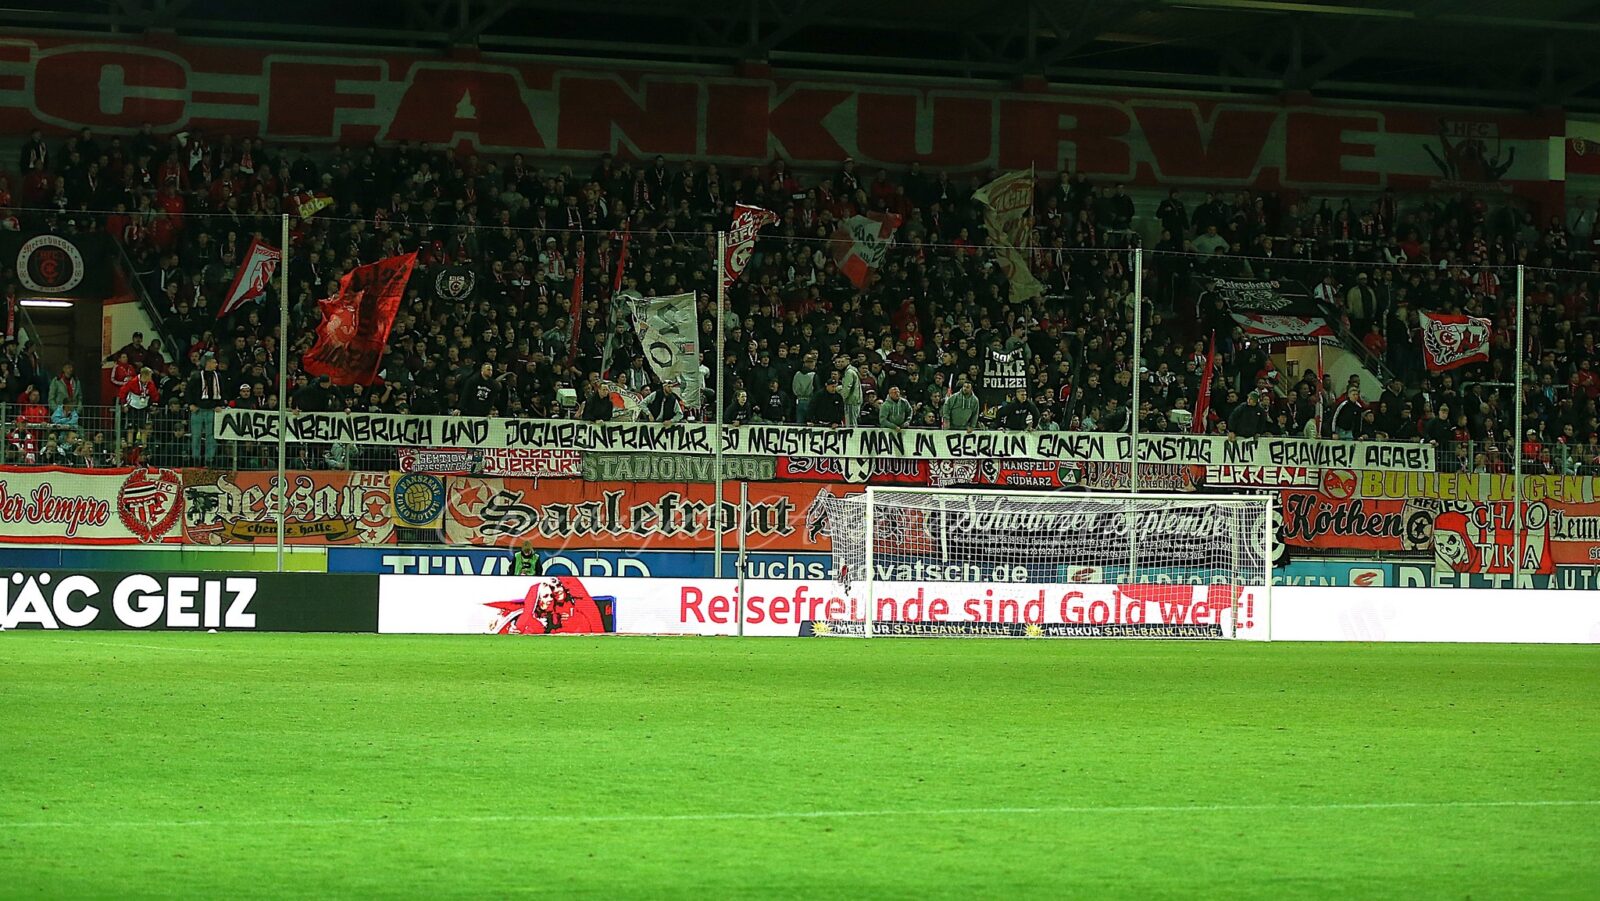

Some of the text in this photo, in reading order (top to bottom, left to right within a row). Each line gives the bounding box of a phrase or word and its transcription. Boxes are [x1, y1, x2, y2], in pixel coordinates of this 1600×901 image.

[0, 43, 1385, 190] C-FANKURVE
[1453, 122, 1490, 136] HFC
[984, 359, 1026, 376] LIKE
[983, 377, 1027, 389] POLIZEI
[219, 411, 432, 444] NASENBEINBRUCH
[443, 419, 489, 446] UND
[748, 426, 854, 456] MEISTERT
[861, 431, 905, 456] MAN
[914, 433, 936, 457] IN
[947, 433, 1026, 458] BERLIN
[1037, 433, 1104, 460] EINEN
[1116, 436, 1212, 463] DENSTAG
[1223, 439, 1258, 464] MIT
[1269, 440, 1356, 466] BRAVUR!
[1366, 445, 1429, 469] ACAB!
[483, 456, 582, 472] QUERFURT
[1002, 461, 1056, 471] MANSFELD
[1205, 465, 1320, 485] SURREALE
[401, 474, 442, 496] FANSZENE
[1006, 474, 1052, 486] SÜDHARZ
[1119, 475, 1185, 489] Ledenschaft
[1361, 470, 1480, 500] BULLEN
[1489, 472, 1584, 502] JAGEN
[27, 483, 109, 537] Sempre
[216, 474, 369, 524] Dessau
[396, 492, 442, 521] LOKOMOTIVE
[479, 488, 799, 539] Saalefront
[1283, 493, 1405, 541] Köthen
[1550, 508, 1600, 540] Leun
[113, 573, 258, 630] GEIZ
[681, 585, 949, 624] Reisefreunde
[963, 588, 1045, 624] sind
[1060, 590, 1146, 625] Gold
[894, 625, 965, 636] SPIELBANK
[970, 625, 1011, 636] HALLE
[1048, 626, 1218, 638] MERKUR SPIELBANK HALLE
